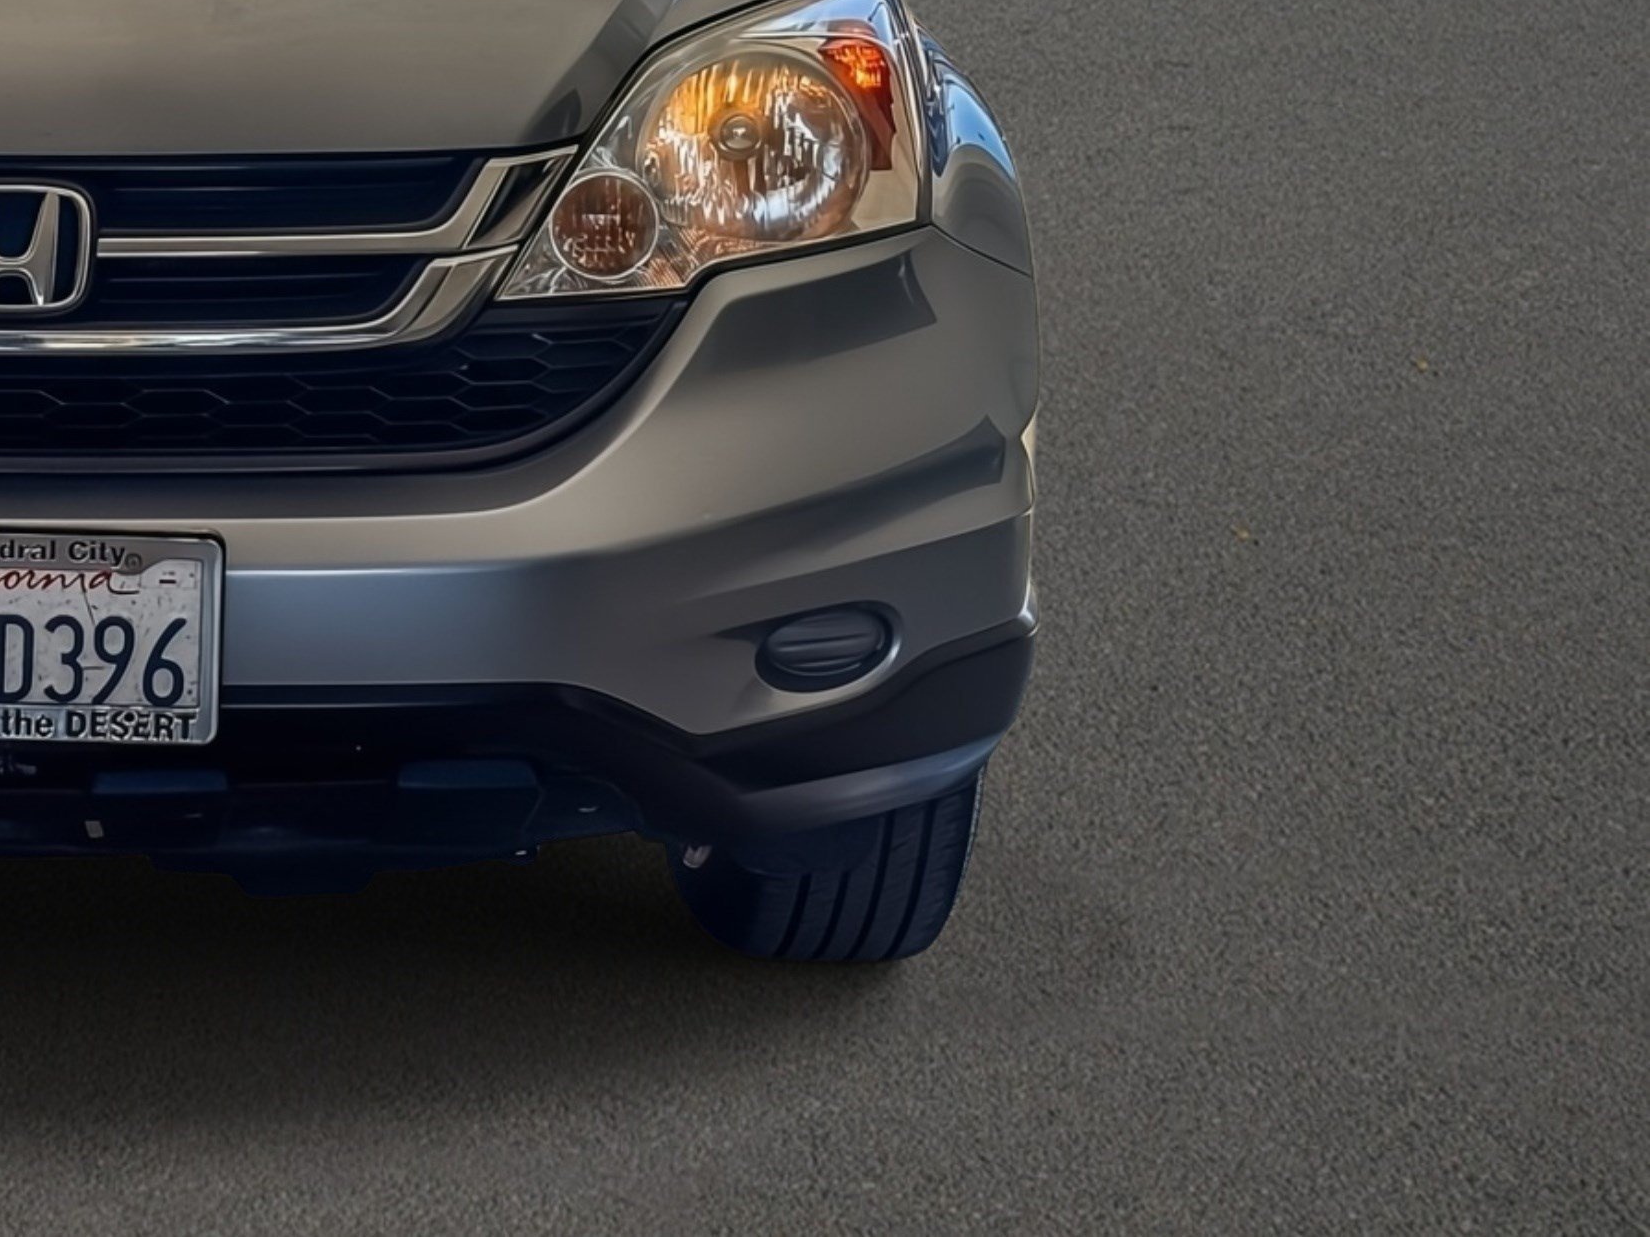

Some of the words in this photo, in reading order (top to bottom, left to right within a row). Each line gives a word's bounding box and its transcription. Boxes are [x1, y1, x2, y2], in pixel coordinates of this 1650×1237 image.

[67, 539, 126, 567] City
[1, 707, 54, 738] the
[65, 709, 197, 741] DESERT
